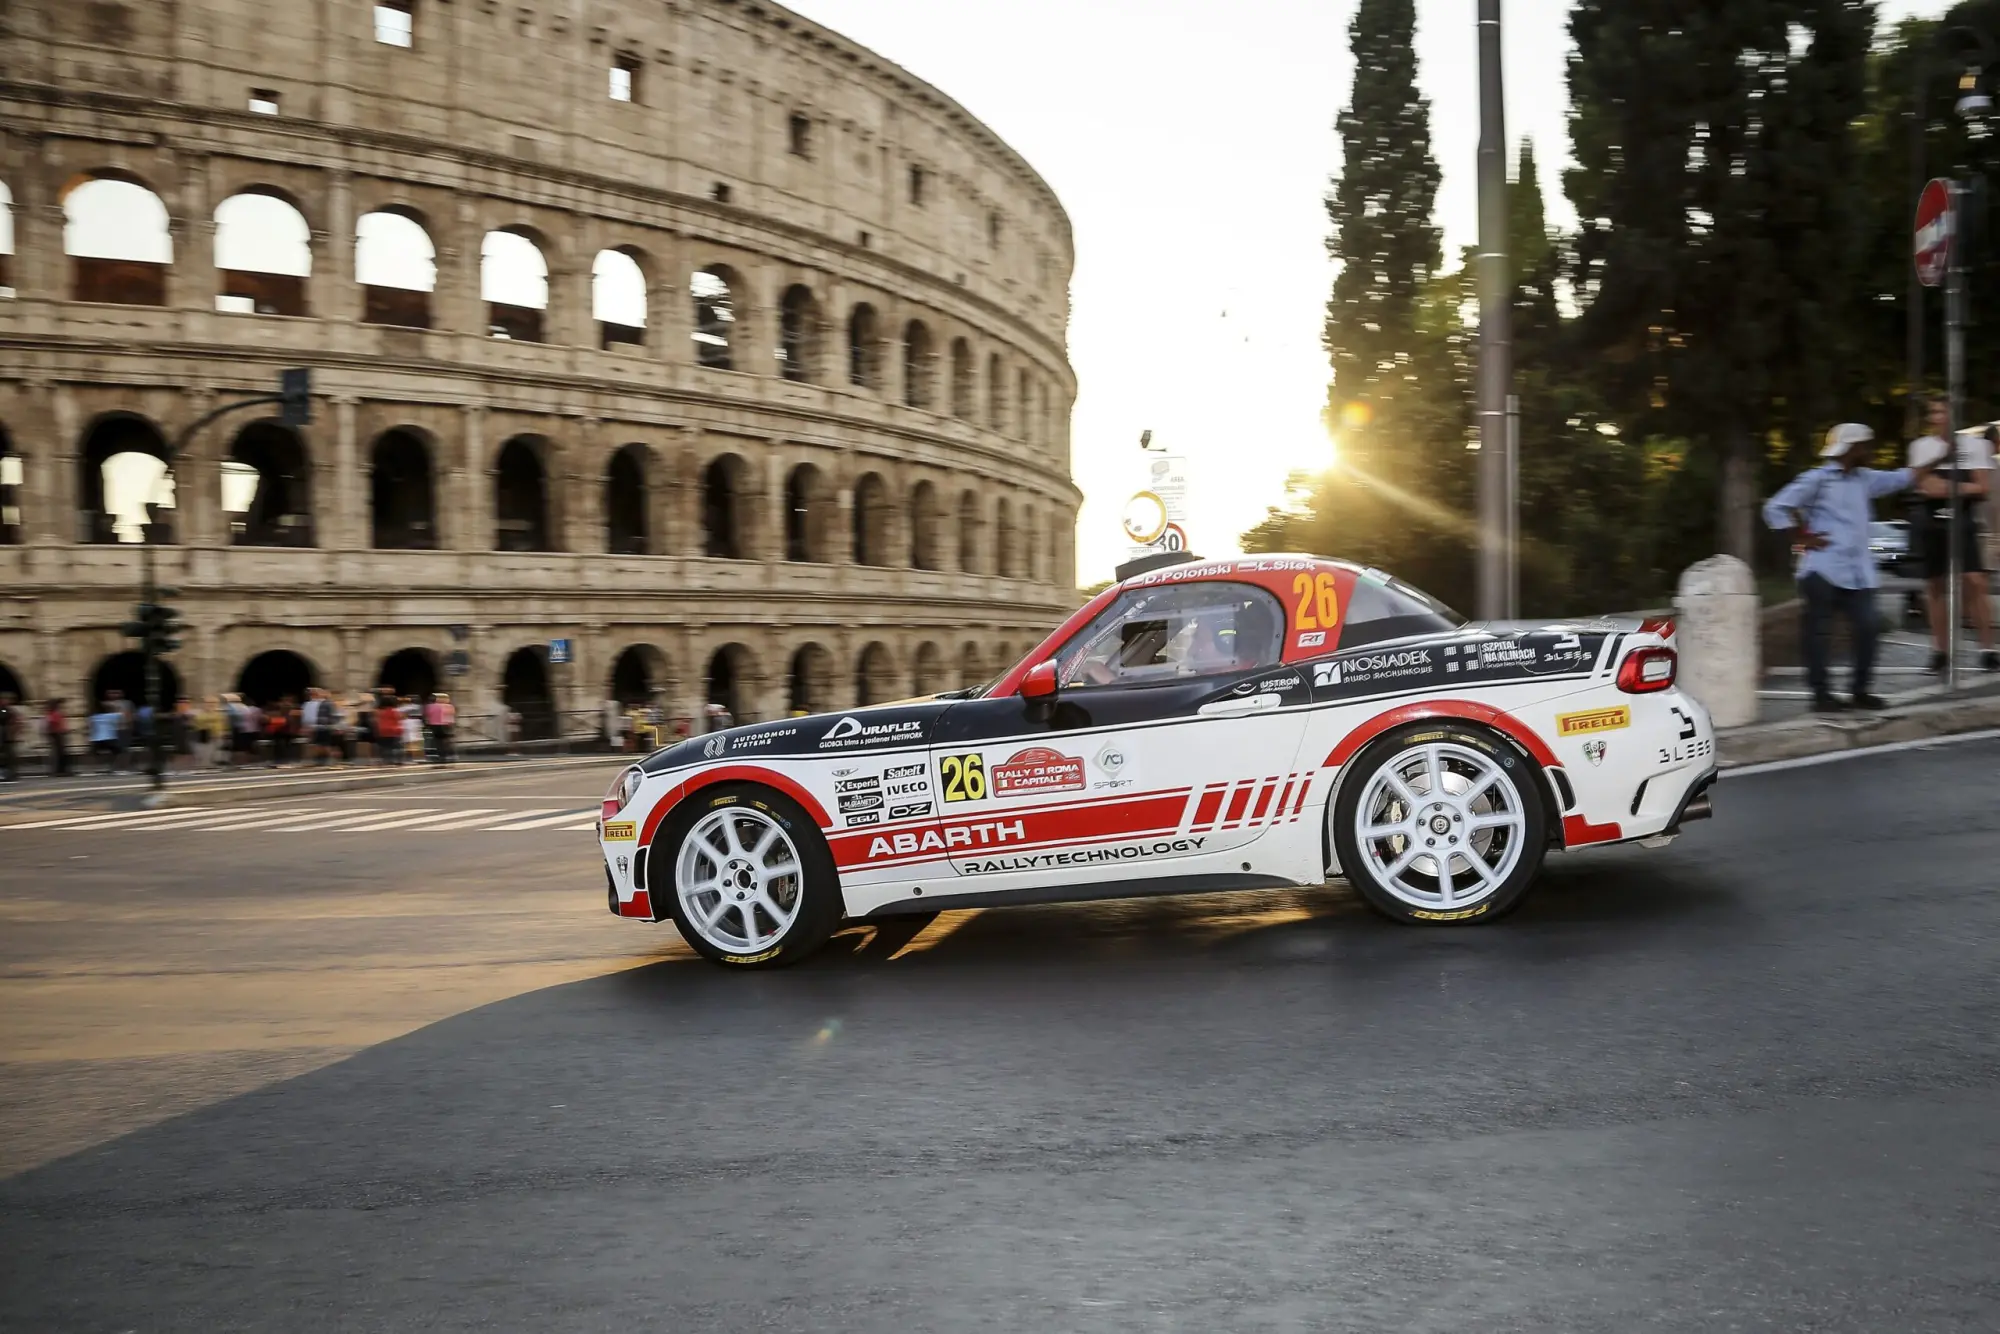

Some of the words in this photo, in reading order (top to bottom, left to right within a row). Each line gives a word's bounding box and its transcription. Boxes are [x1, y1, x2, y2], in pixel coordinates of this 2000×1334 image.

[1293, 572, 1339, 630] 26
[1482, 641, 1518, 652] SZPITAL
[1342, 650, 1431, 673] NOSIADEK
[1343, 674, 1371, 683] BIURO
[1562, 709, 1625, 732] PIRELLI
[734, 729, 796, 743] AUTONOMOUS
[732, 739, 772, 749] SYSTEMS
[887, 765, 921, 779] Sabelt
[942, 753, 985, 802] 26
[996, 769, 1031, 779] RALLY
[1034, 767, 1044, 775] DI
[1047, 764, 1079, 774] ROMA
[1014, 775, 1063, 786] CAPITALE
[1093, 779, 1133, 789] SPORT
[887, 781, 928, 796] IVECO
[605, 825, 633, 838] PIRELLI
[868, 820, 1025, 858] ABARTH
[964, 837, 1207, 873] RALLYTECHNOLOGY
